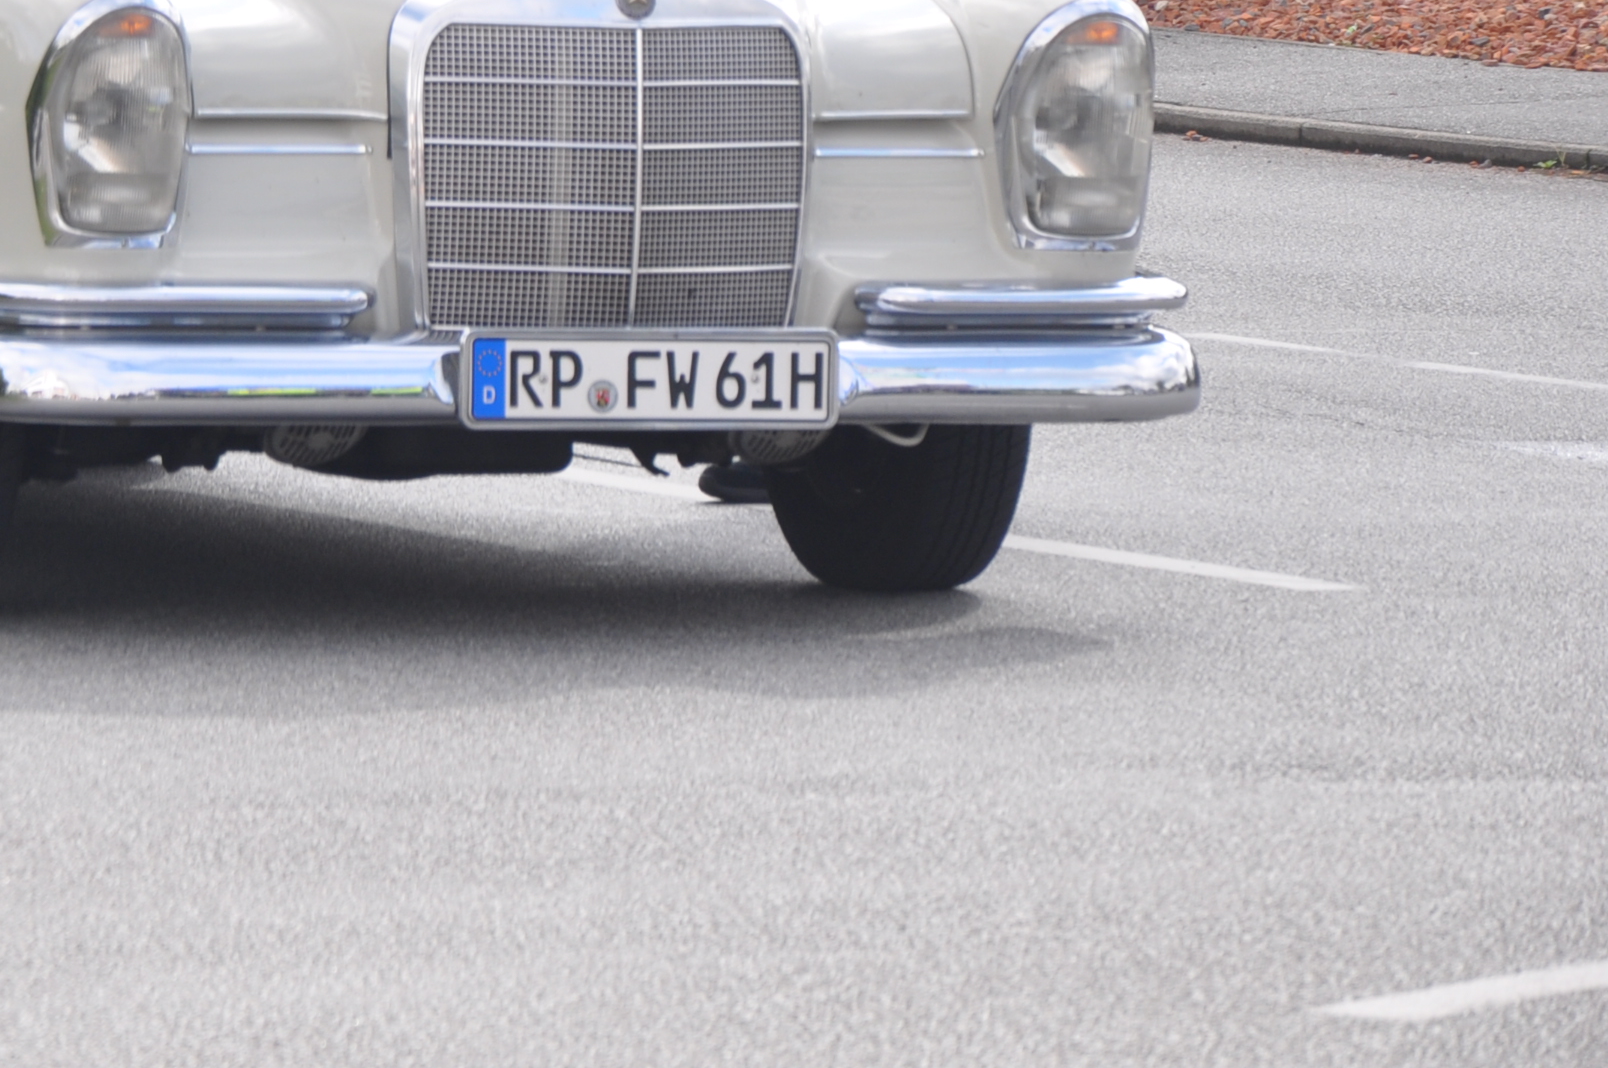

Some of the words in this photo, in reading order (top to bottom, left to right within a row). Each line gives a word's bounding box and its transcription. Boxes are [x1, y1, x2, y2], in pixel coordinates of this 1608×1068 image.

[482, 385, 497, 405] D
[509, 349, 584, 409] RP
[626, 350, 700, 409] FW
[715, 351, 824, 410] 61H
